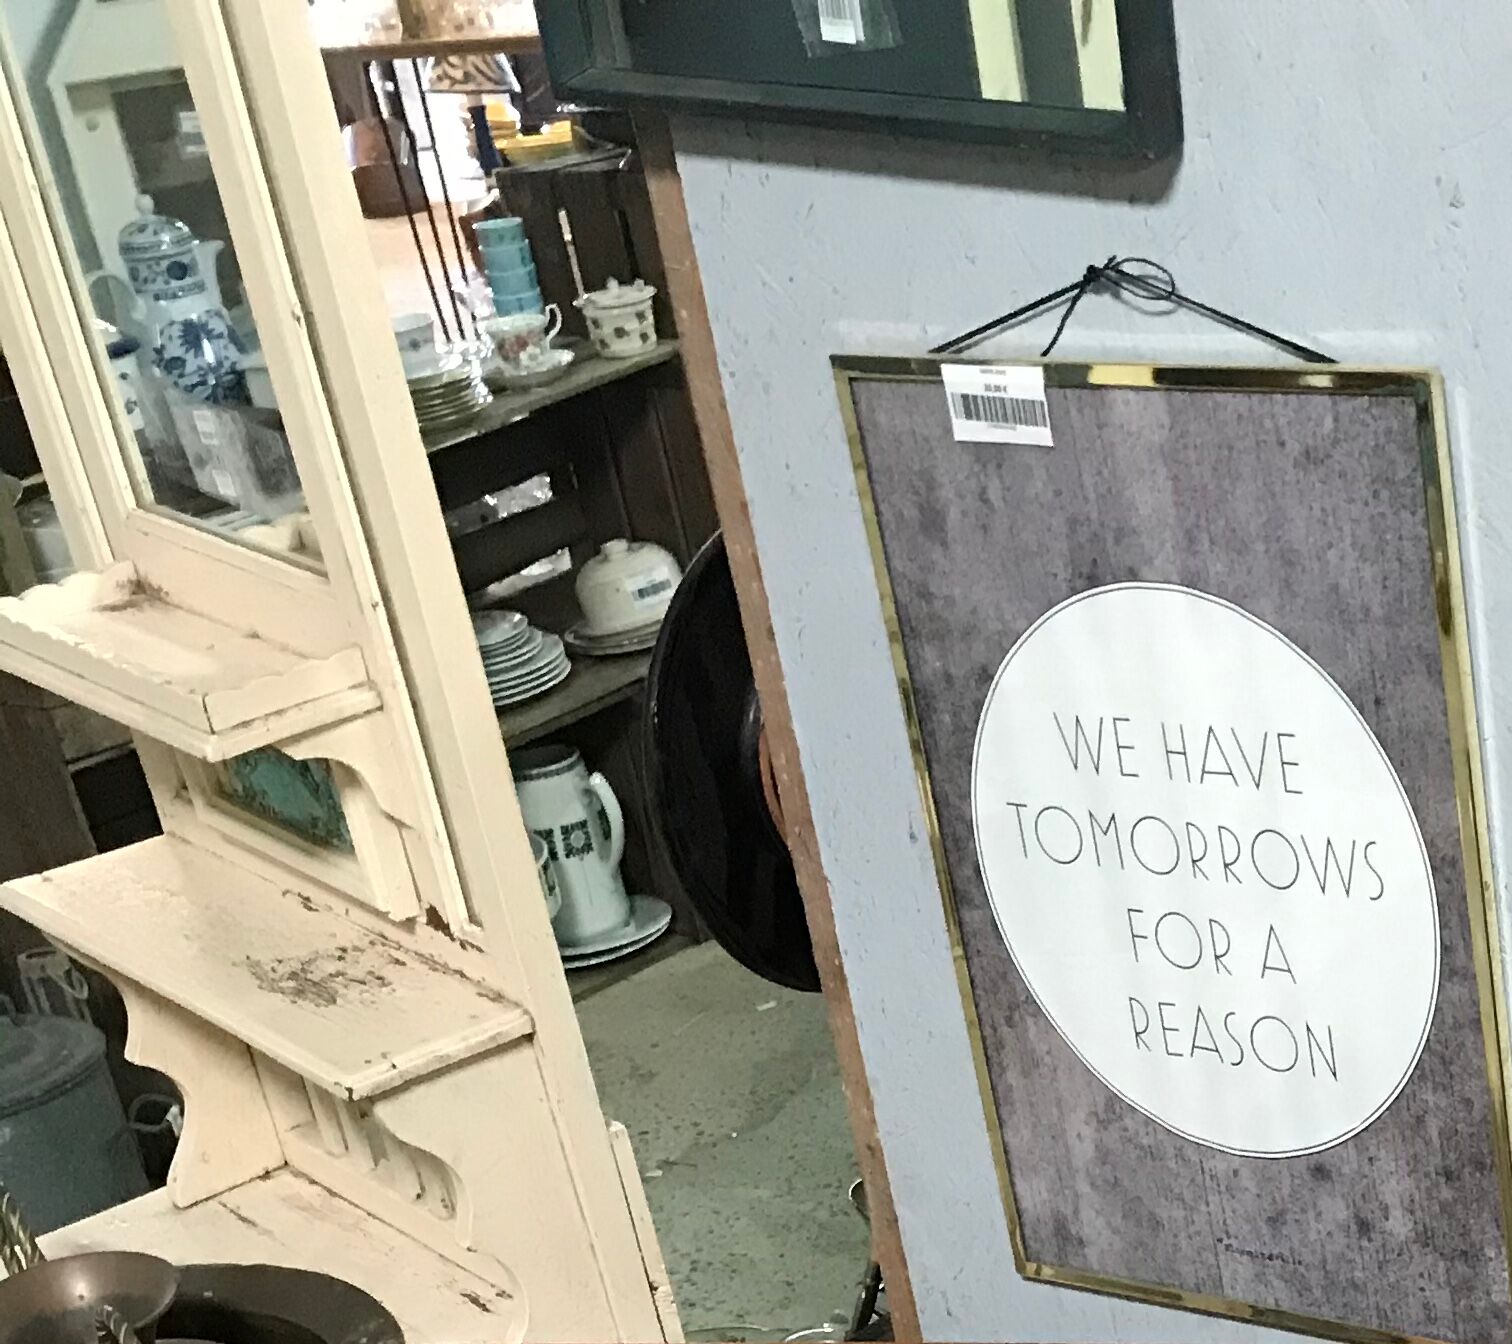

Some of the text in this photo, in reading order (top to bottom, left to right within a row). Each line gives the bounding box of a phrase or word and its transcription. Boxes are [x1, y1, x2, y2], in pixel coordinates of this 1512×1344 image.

[1053, 711, 1303, 795] WE HAVE
[1006, 801, 1384, 901] TOMORROWS
[1126, 907, 1297, 985] FOR A
[1127, 996, 1339, 1082] REASON
